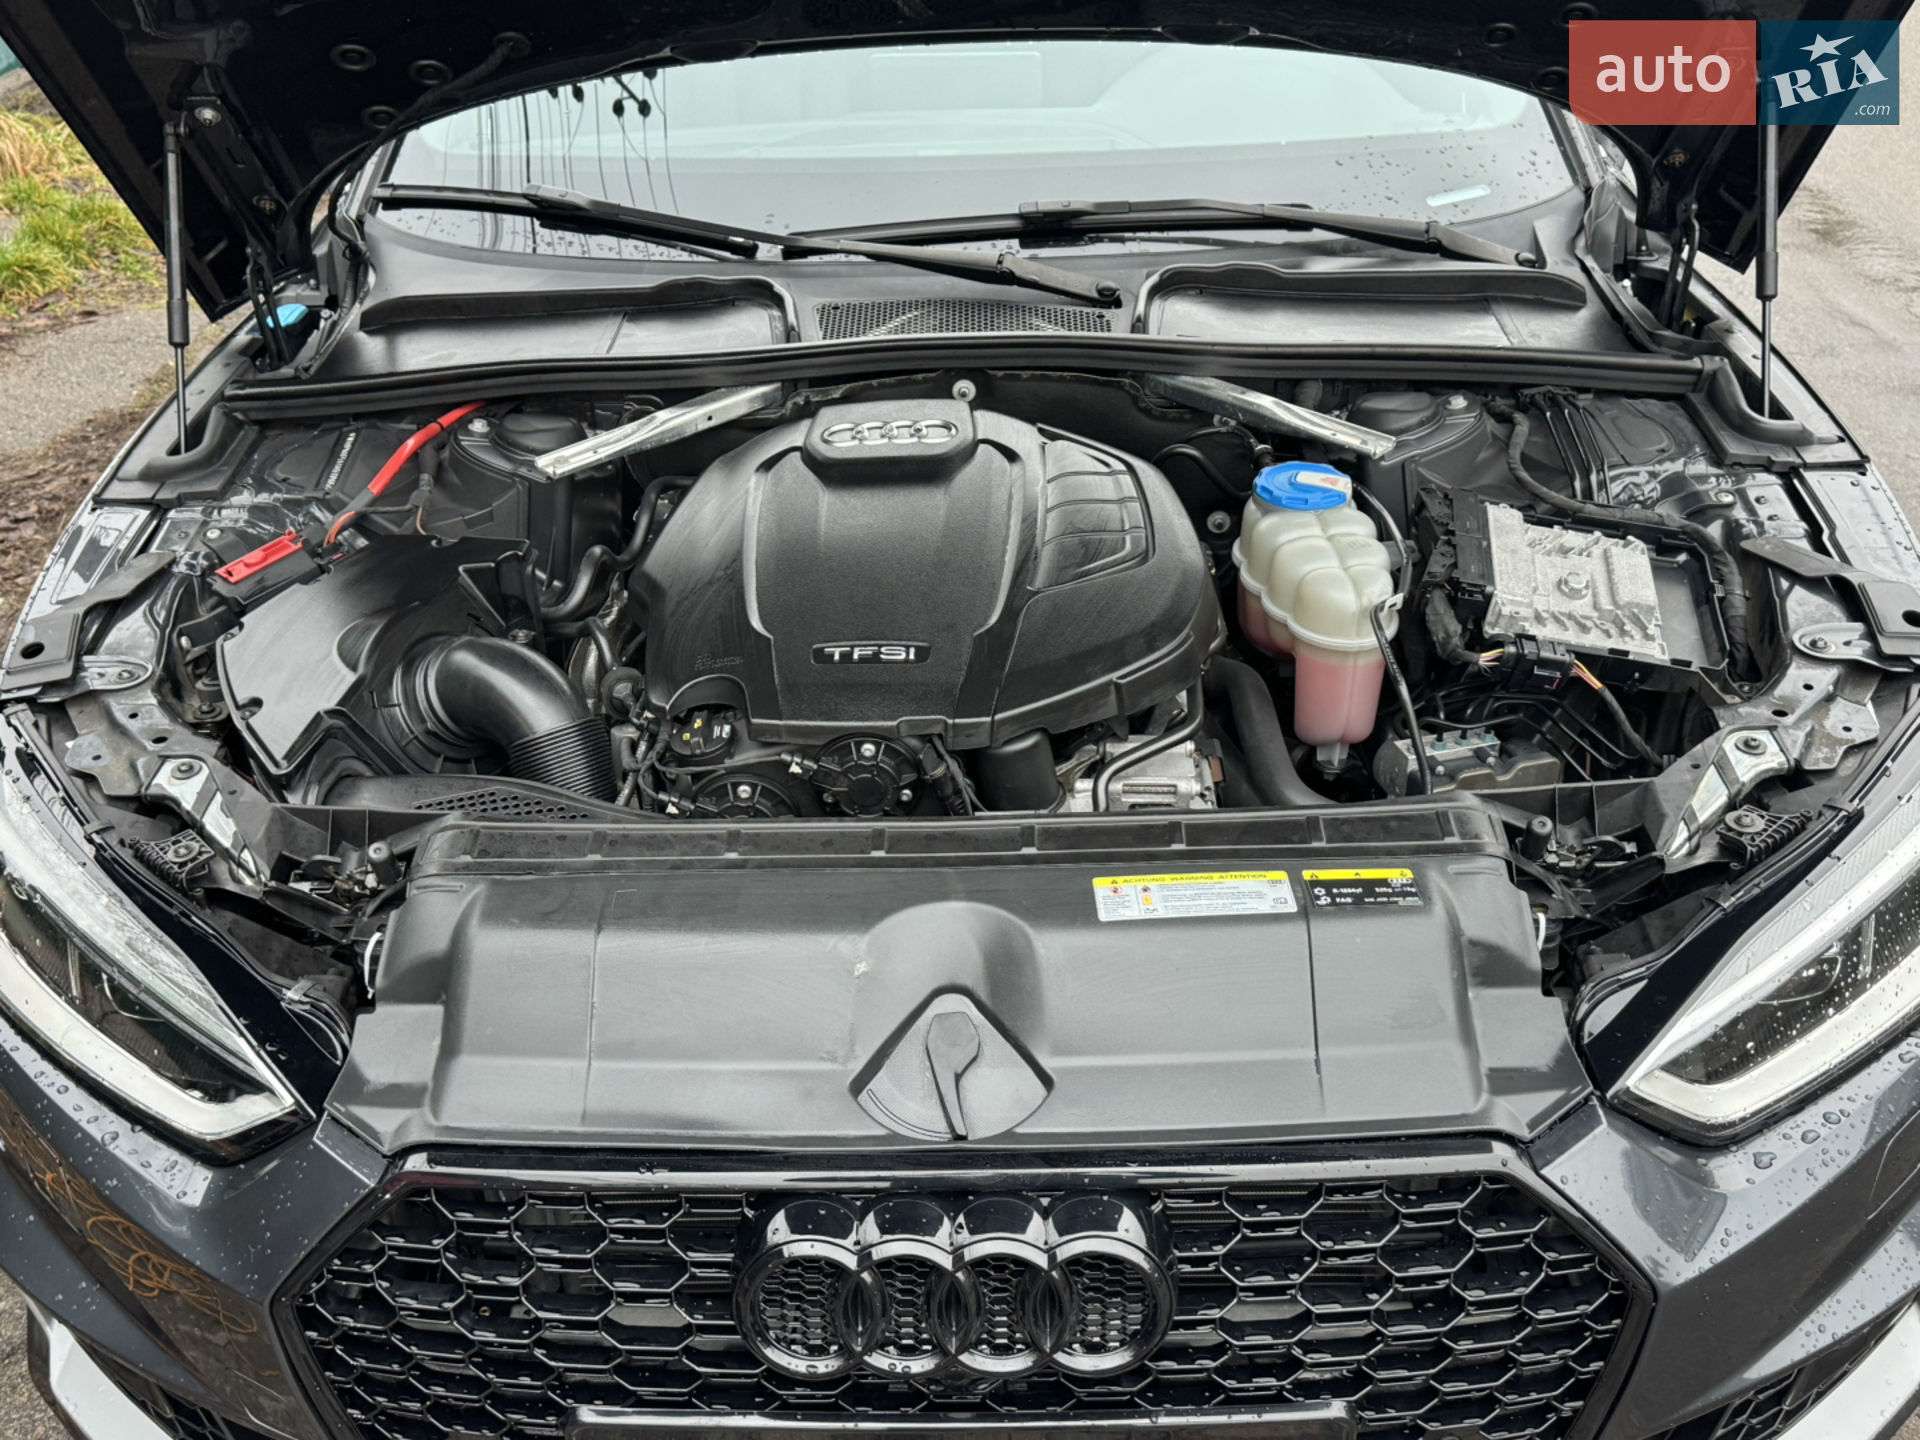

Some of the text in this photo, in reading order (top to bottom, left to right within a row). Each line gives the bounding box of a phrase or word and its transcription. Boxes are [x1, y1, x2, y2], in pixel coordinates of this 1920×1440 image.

[824, 646, 916, 662] TFSI
[1122, 872, 1268, 884] ACHTUNG WARNING ATTENTION
